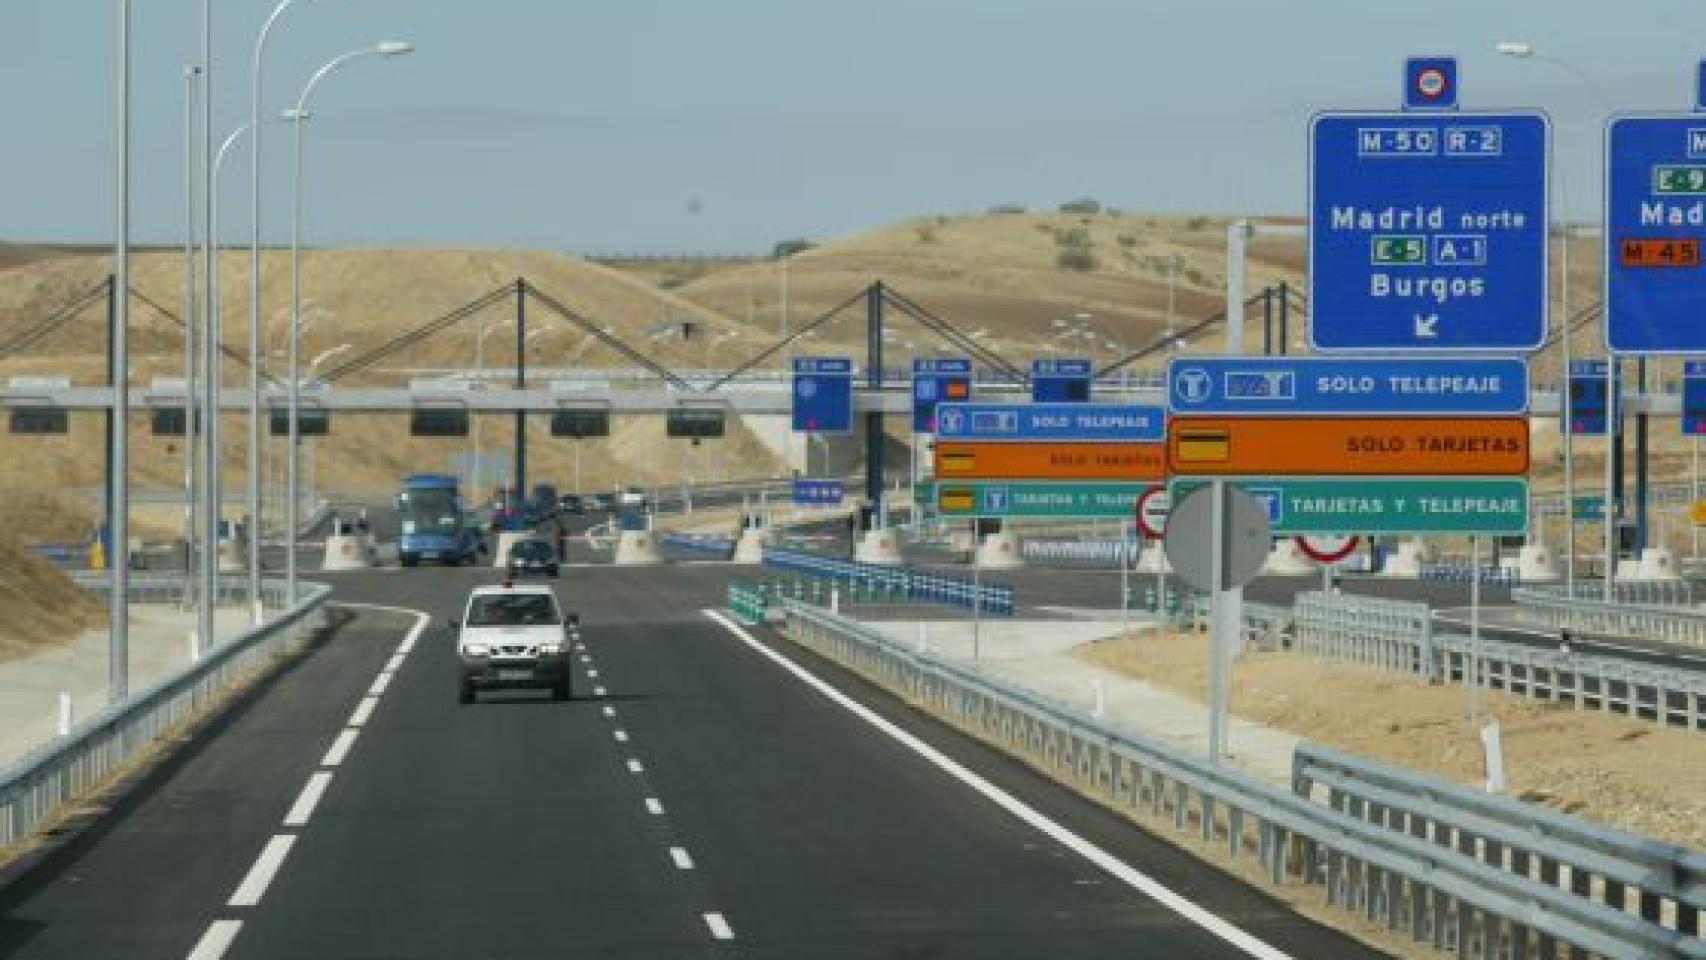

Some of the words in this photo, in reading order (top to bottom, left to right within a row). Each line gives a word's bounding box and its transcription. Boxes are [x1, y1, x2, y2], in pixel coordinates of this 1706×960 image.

[1364, 132, 1433, 151] M-50
[1449, 131, 1498, 151] R-2
[1331, 206, 1443, 230] Madrid
[1461, 210, 1525, 229] norte
[1374, 238, 1423, 261] E-5
[1439, 238, 1485, 261] A-1
[1624, 242, 1698, 260] M-45
[1370, 273, 1486, 303] Burgos
[1316, 375, 1376, 394] SOLO
[1387, 375, 1501, 394] TELEPEAJE
[1077, 414, 1150, 428] TELEPEAJE
[1346, 435, 1406, 454] SOLO
[1415, 435, 1520, 454] TARJETAS
[1290, 496, 1384, 513] TARJETAS
[1393, 496, 1406, 513] Y
[1418, 496, 1521, 513] TELEPEAJE
